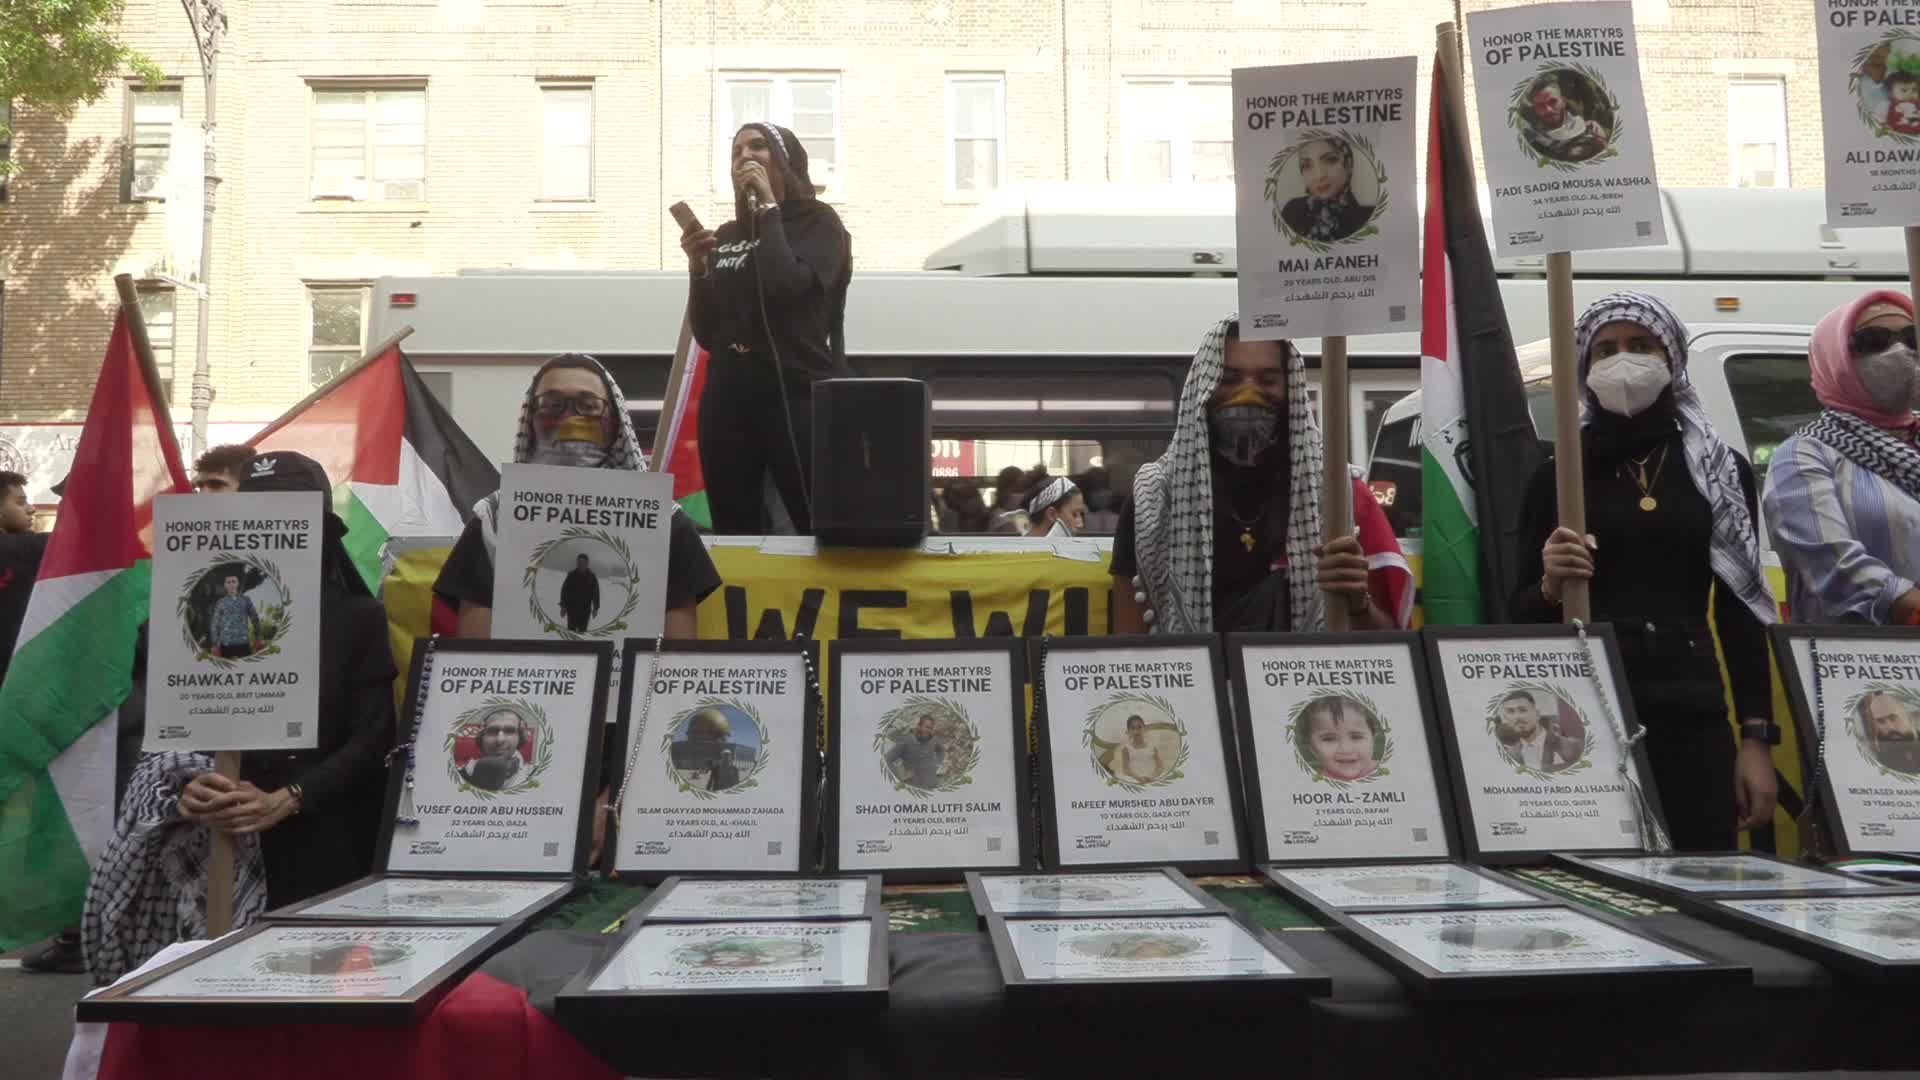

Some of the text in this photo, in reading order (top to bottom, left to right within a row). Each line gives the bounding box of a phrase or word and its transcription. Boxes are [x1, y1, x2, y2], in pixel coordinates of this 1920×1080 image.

[1830, 10, 1858, 27] OF
[1482, 27, 1624, 48] HONOR THE MARTYRS
[1485, 41, 1625, 65] OF PALESTINE
[1246, 88, 1403, 109] HONOR THE MARTYRS
[1247, 103, 1402, 130] OF PALESTINE
[1845, 151, 1870, 164] ALI
[1495, 185, 1522, 198] FADI
[1524, 181, 1560, 194] SADIQ
[1562, 178, 1602, 189] MOUSA
[1278, 254, 1379, 273] MAI AFANEH
[514, 491, 660, 510] HONOR THE MARTYRS
[514, 505, 658, 529] OF PALESTINE
[165, 519, 309, 532] HONOR THE MARTYRS
[166, 533, 308, 551] OF PALESTINE
[1262, 659, 1393, 671] HONOR THE MARTYRS
[1457, 652, 1587, 663] HONOR THE MARTYRS
[1817, 652, 1855, 663] ONOR
[1856, 653, 1881, 664] THE
[441, 667, 577, 679] HONOR THE MARTYRS
[654, 668, 788, 678] HONOR THE MARTYRS
[860, 666, 992, 678] HONOR THE MARTYRS
[1062, 662, 1193, 674] HONOR THE MARTYRS
[1462, 663, 1592, 679] OF PALESTINE
[167, 672, 299, 687] SHAWKAT AWAD
[1065, 673, 1195, 691] OF PALESTINE
[1264, 670, 1395, 687] OF PALESTINE
[440, 679, 576, 696] OF PALESTINE
[653, 680, 786, 695] OF PALESTINE
[860, 678, 991, 695] OF PALESTINE
[1483, 785, 1625, 795] MOHAMMAD FARID ALI HASAN
[1071, 797, 1215, 809] RAFEEF MURSHED ABU DAYER
[1292, 791, 1406, 805] HOOR AL-ZAMLI
[416, 804, 564, 816] YUSEF QADIR ABU HUSSEIN
[702, 807, 750, 815] MOHAMMAD
[855, 802, 1001, 814] SHADI OMAR LUTFI SALIM
[462, 819, 486, 827] YEARS
